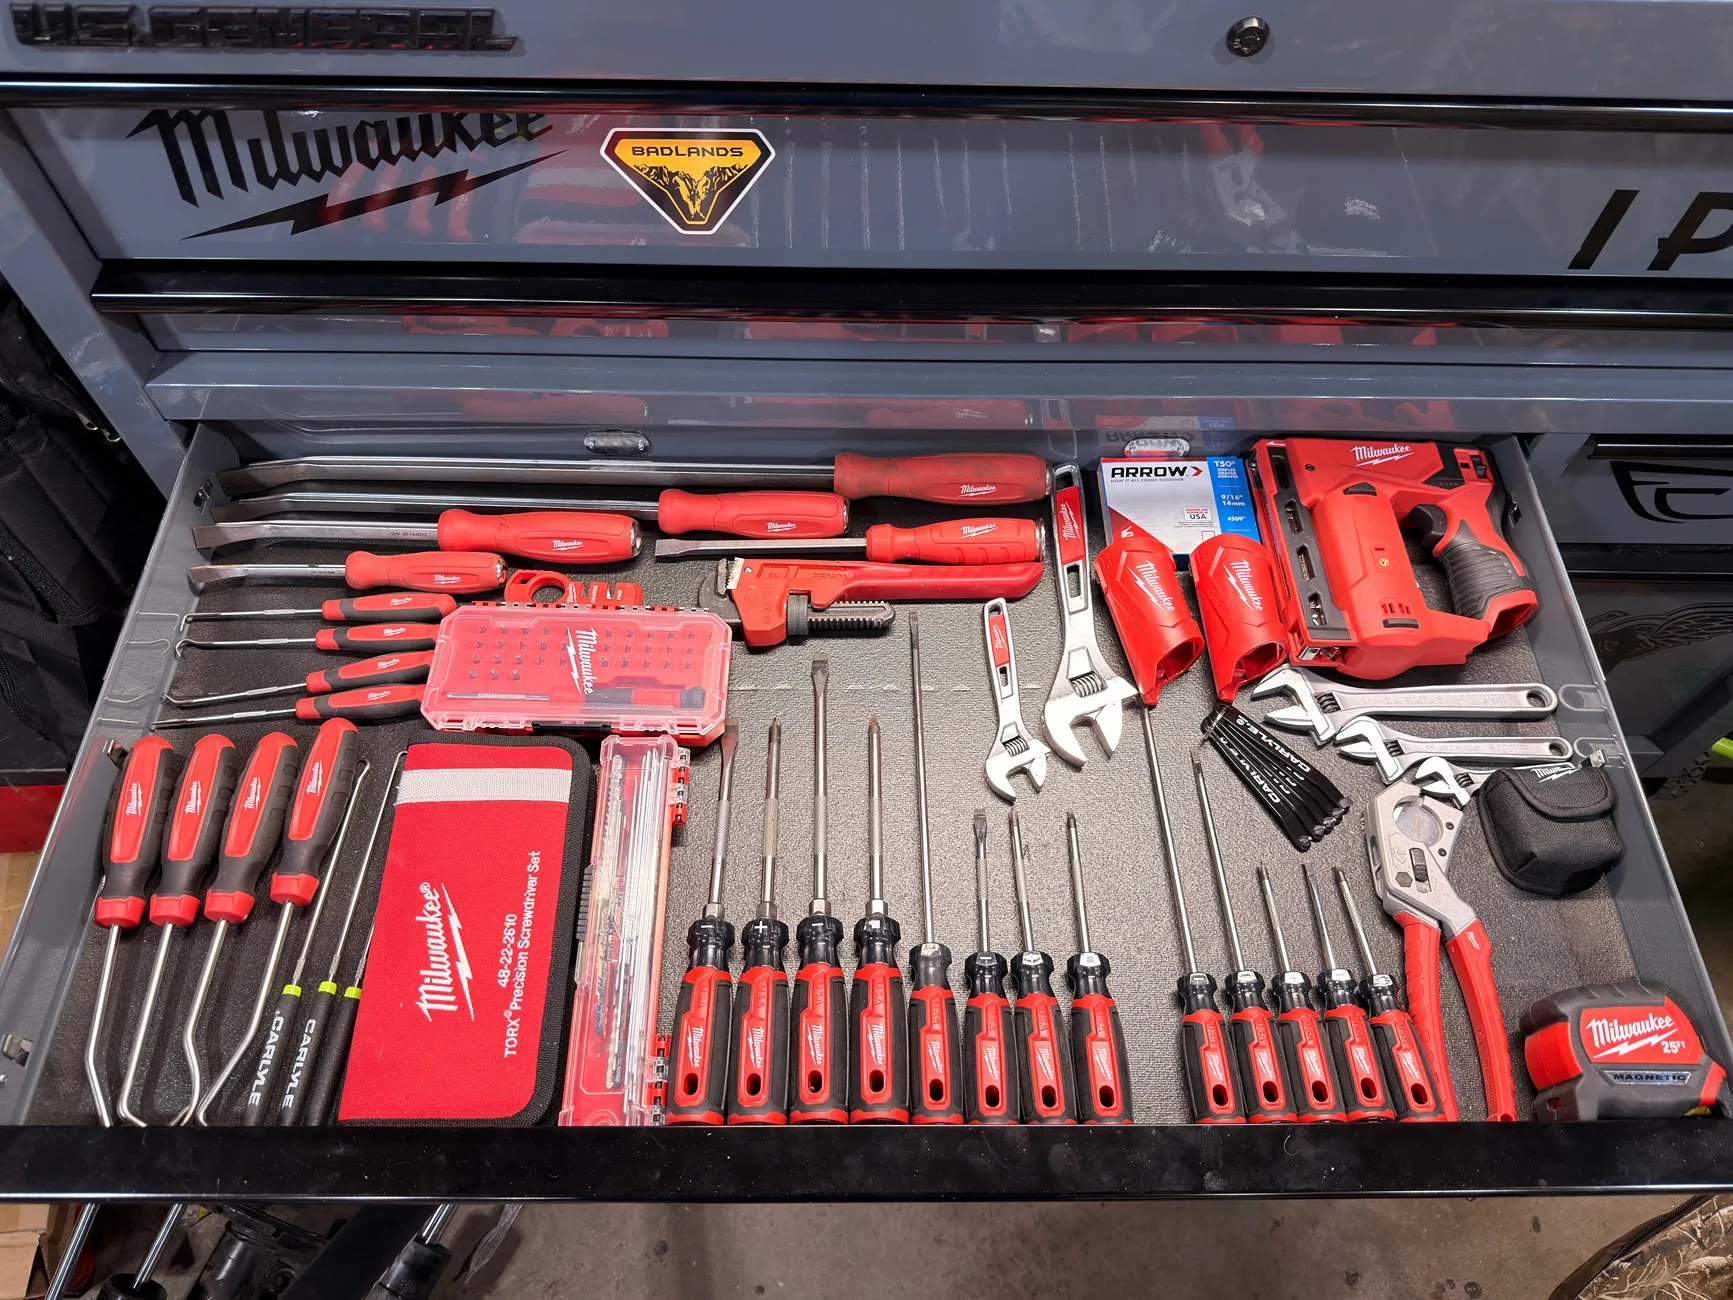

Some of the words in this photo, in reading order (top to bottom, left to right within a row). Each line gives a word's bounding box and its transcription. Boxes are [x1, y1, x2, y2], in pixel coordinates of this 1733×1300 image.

[125, 109, 553, 208] Milwaukee
[632, 145, 744, 157] BADLANDS
[1349, 443, 1412, 461] Milwaukee
[960, 484, 997, 494] Milwaukee
[1111, 466, 1188, 478] ARROW
[767, 522, 797, 530] Milwaukee
[961, 523, 998, 535] Milwaukee
[1062, 502, 1077, 541] Milwaukee
[552, 539, 584, 548] Milwaukee
[433, 574, 461, 582] Milwaukee
[590, 585, 599, 604] COARSE
[1136, 559, 1175, 613] Milwaukee
[1230, 558, 1264, 612] Milwaukee
[992, 624, 1004, 650] Milwaukee
[576, 627, 599, 695] Milwaukee
[243, 776, 258, 810] Milwaukee
[306, 761, 320, 795] Milwaukee
[125, 782, 138, 816] Milwaukee
[184, 780, 198, 815] Milwaukee
[527, 851, 541, 873] Set
[517, 874, 538, 949] Screwdriver
[498, 913, 517, 988] 48-22-2610
[509, 951, 529, 1011] Precision
[692, 1026, 705, 1068] Milwaukee
[752, 1026, 765, 1069] Milwaukee
[812, 1024, 824, 1065] Milwaukee
[872, 1024, 885, 1065] Milwaukee
[1585, 1013, 1675, 1048] Milwaukee
[248, 1016, 285, 1107] CARLYLE
[281, 1019, 317, 1109] CARLYLE
[931, 1040, 943, 1074] Milwaukee
[986, 1047, 1000, 1080] Milwaukee
[1039, 1047, 1055, 1081] Milwaukee
[1097, 1047, 1112, 1081] Milwaukee
[1210, 1053, 1224, 1081] Milwaukee
[1259, 1051, 1273, 1079] Milwaukee
[1306, 1049, 1322, 1077] Milwaukee
[1355, 1047, 1371, 1074] Milwaukee
[1402, 1052, 1421, 1079] Milwaukee
[1613, 1073, 1687, 1081] MAGNETIC
